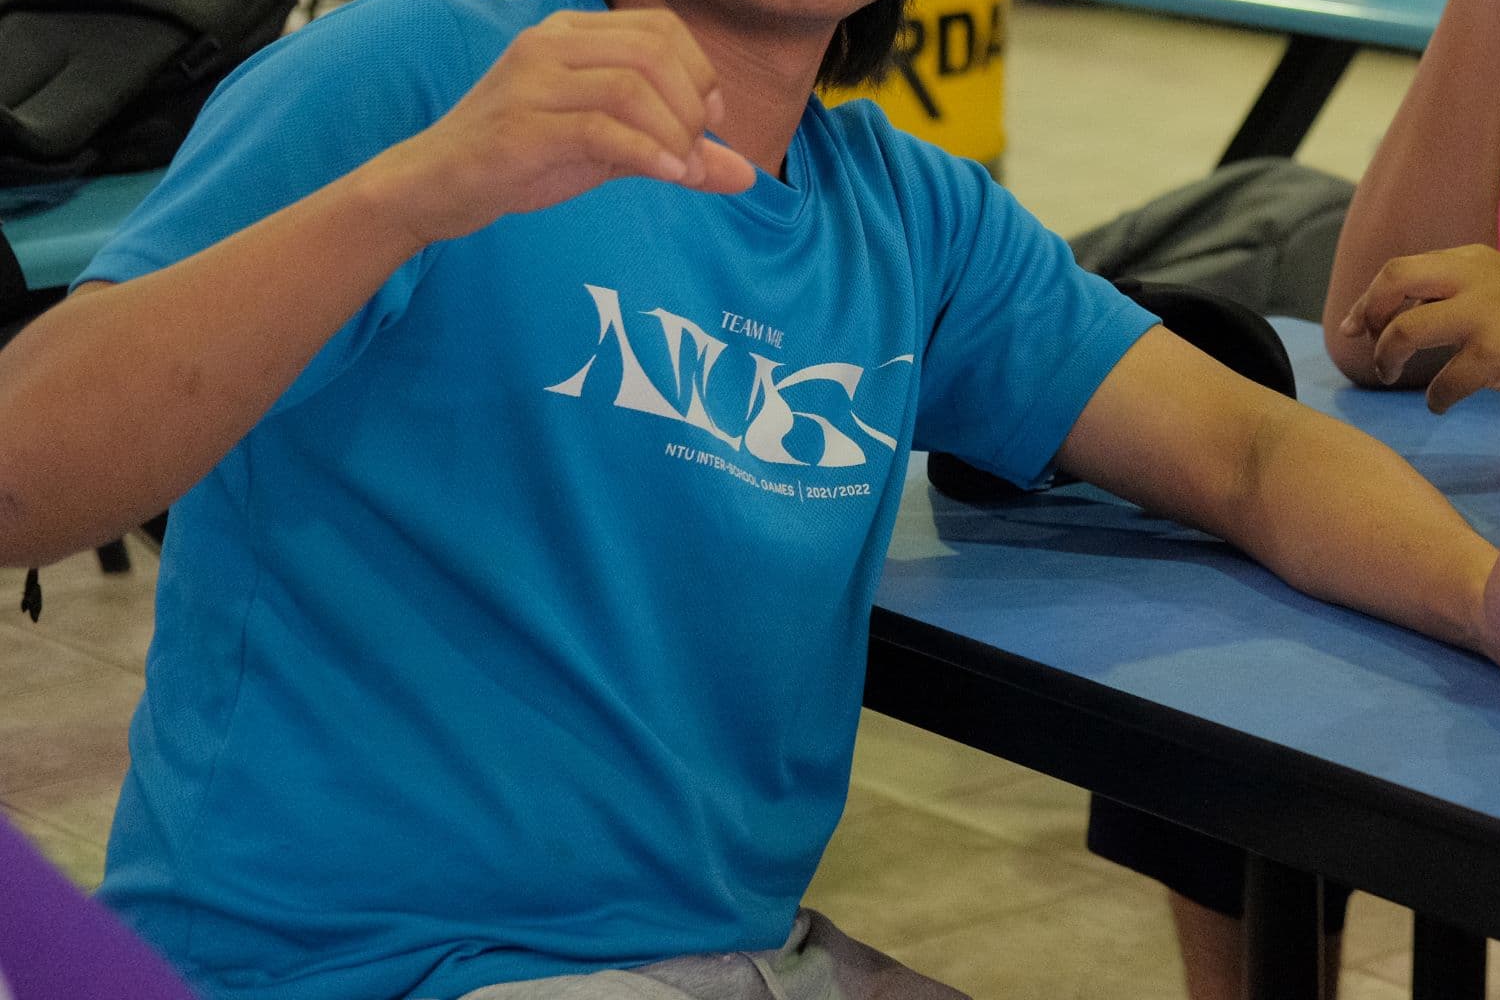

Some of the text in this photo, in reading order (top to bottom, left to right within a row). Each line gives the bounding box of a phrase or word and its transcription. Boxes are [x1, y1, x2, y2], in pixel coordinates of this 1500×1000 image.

[721, 310, 764, 341] TEAM
[664, 443, 871, 499] NTU INTER-SCHOOL GAMES 2021/2022
